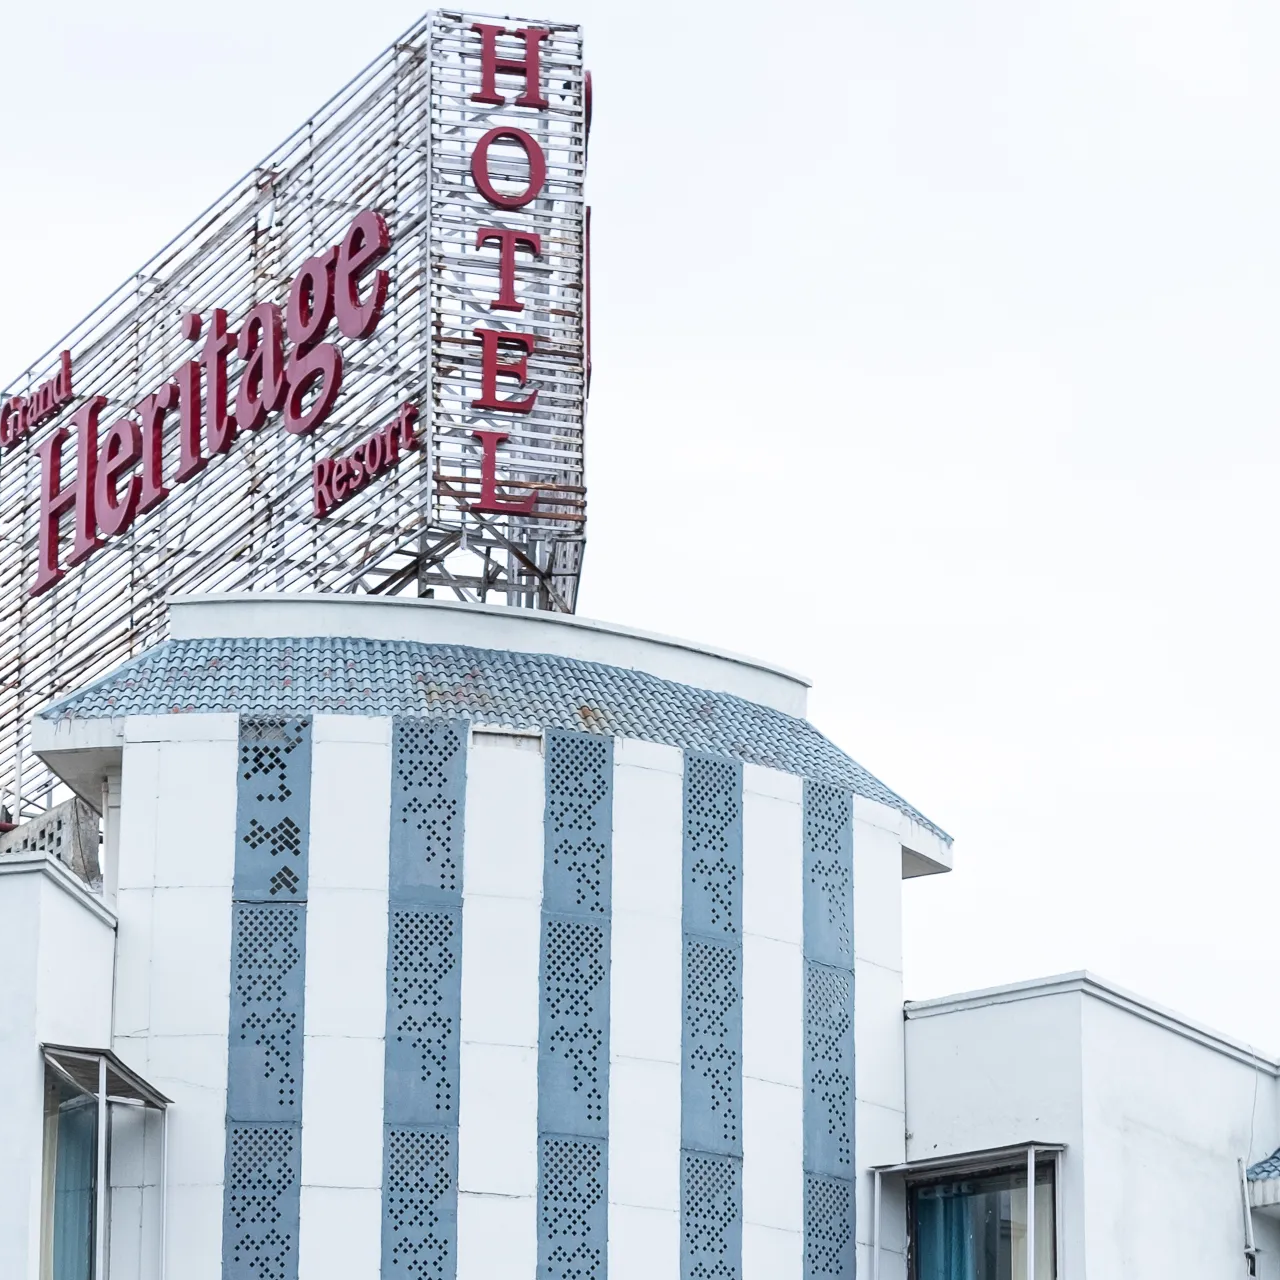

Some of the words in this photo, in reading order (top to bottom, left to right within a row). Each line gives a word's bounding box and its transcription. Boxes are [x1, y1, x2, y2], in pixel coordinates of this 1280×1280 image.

[29, 210, 390, 597] Heritage
[312, 402, 419, 518] Resort
[471, 23, 549, 513] HOTEL
